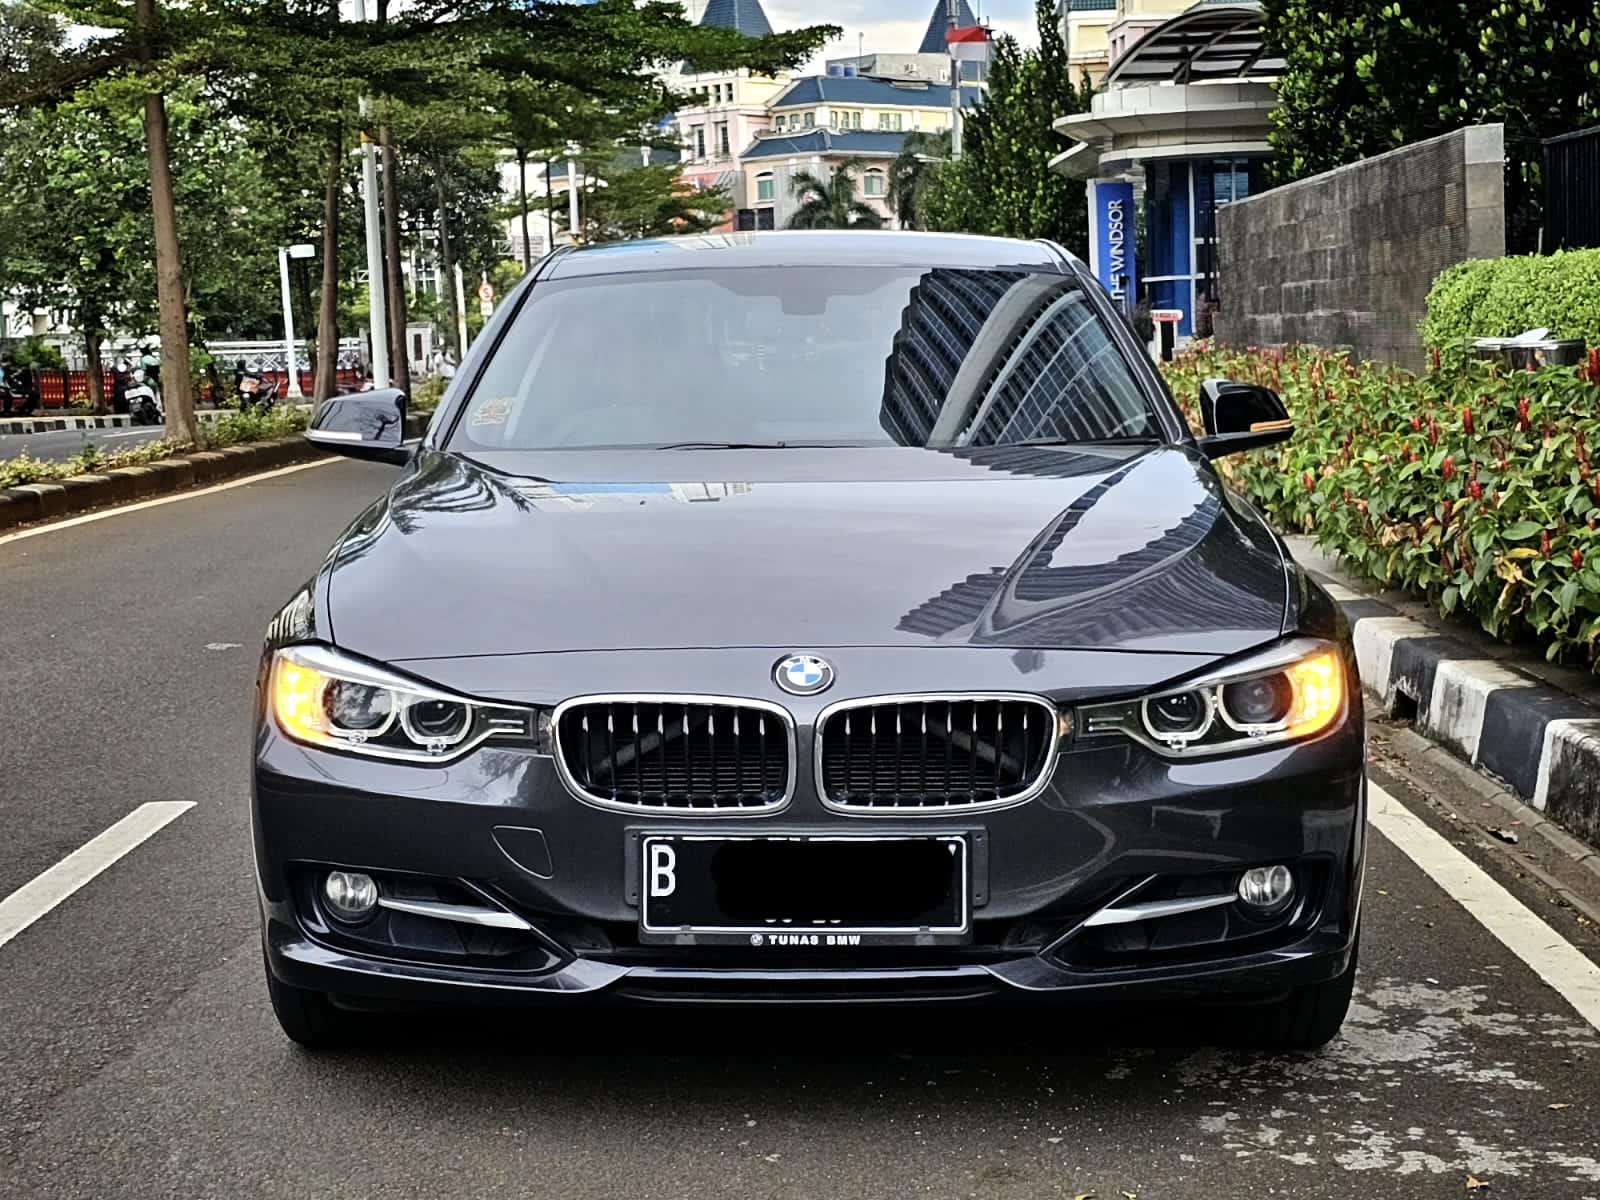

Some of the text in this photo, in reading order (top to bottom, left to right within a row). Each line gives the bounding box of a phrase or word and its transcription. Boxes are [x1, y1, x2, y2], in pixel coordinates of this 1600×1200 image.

[1108, 199, 1125, 272] WINDSOR
[651, 844, 676, 897] B
[768, 935, 861, 945] TUNAS BMW
